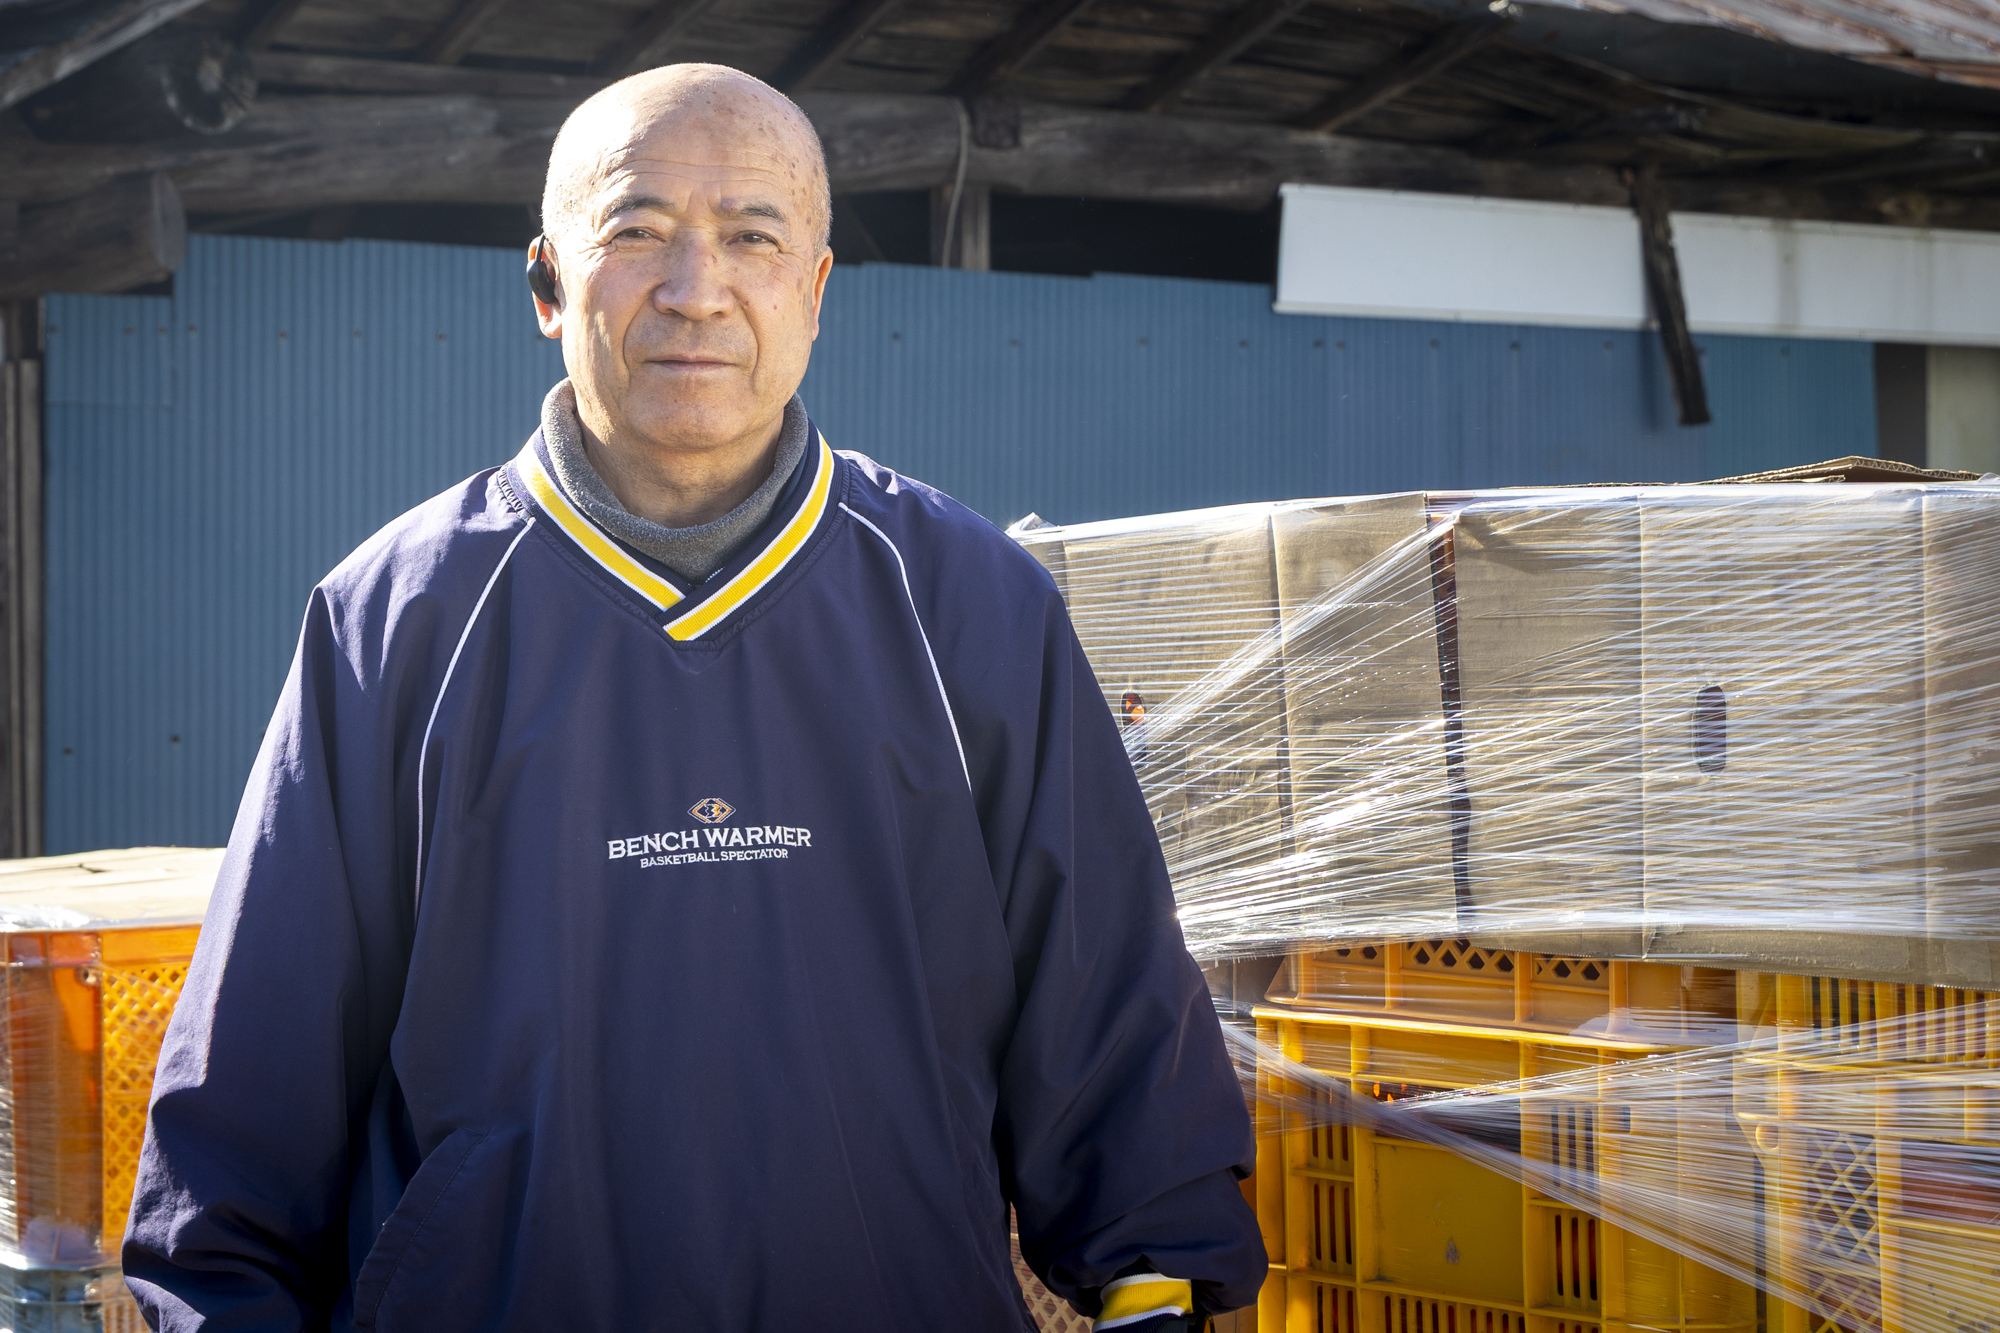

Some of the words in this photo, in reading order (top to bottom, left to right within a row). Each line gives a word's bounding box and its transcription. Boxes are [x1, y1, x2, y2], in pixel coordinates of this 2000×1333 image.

[607, 829, 700, 859] BENCH
[702, 825, 812, 848] WARMER
[640, 851, 720, 869] BASKETBALL
[720, 848, 789, 862] SPECTATOR
